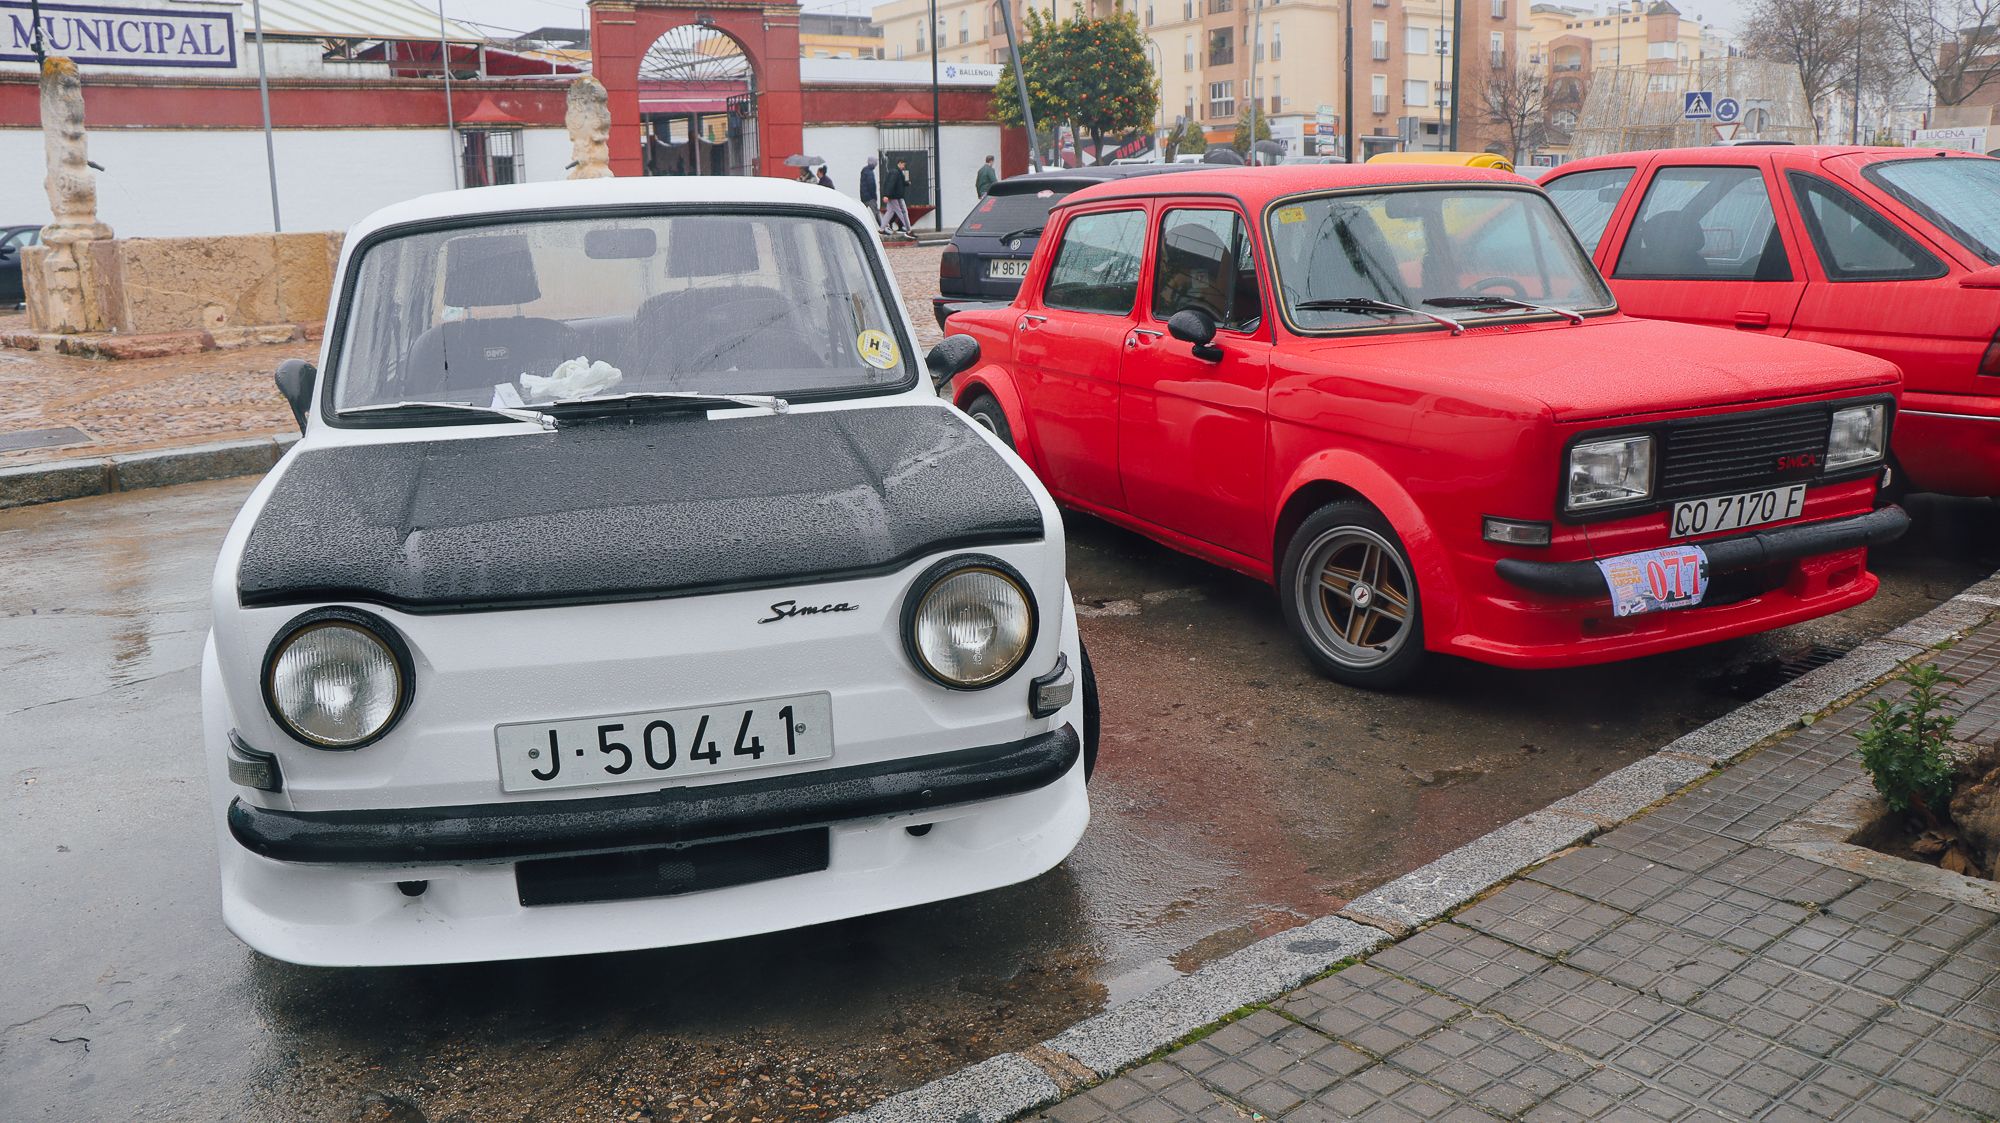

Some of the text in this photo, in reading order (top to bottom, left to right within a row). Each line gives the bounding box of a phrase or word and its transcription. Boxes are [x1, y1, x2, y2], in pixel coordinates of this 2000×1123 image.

[8, 14, 224, 56] MUNICIPAL
[1926, 129, 1965, 139] LUCENA
[1115, 135, 1147, 159] AVANT
[991, 261, 1028, 275] M 9612
[1776, 453, 1816, 471] SIMCA
[1674, 486, 1804, 535] CO 7170 F
[1646, 554, 1699, 601] 077
[757, 599, 860, 625] Simca
